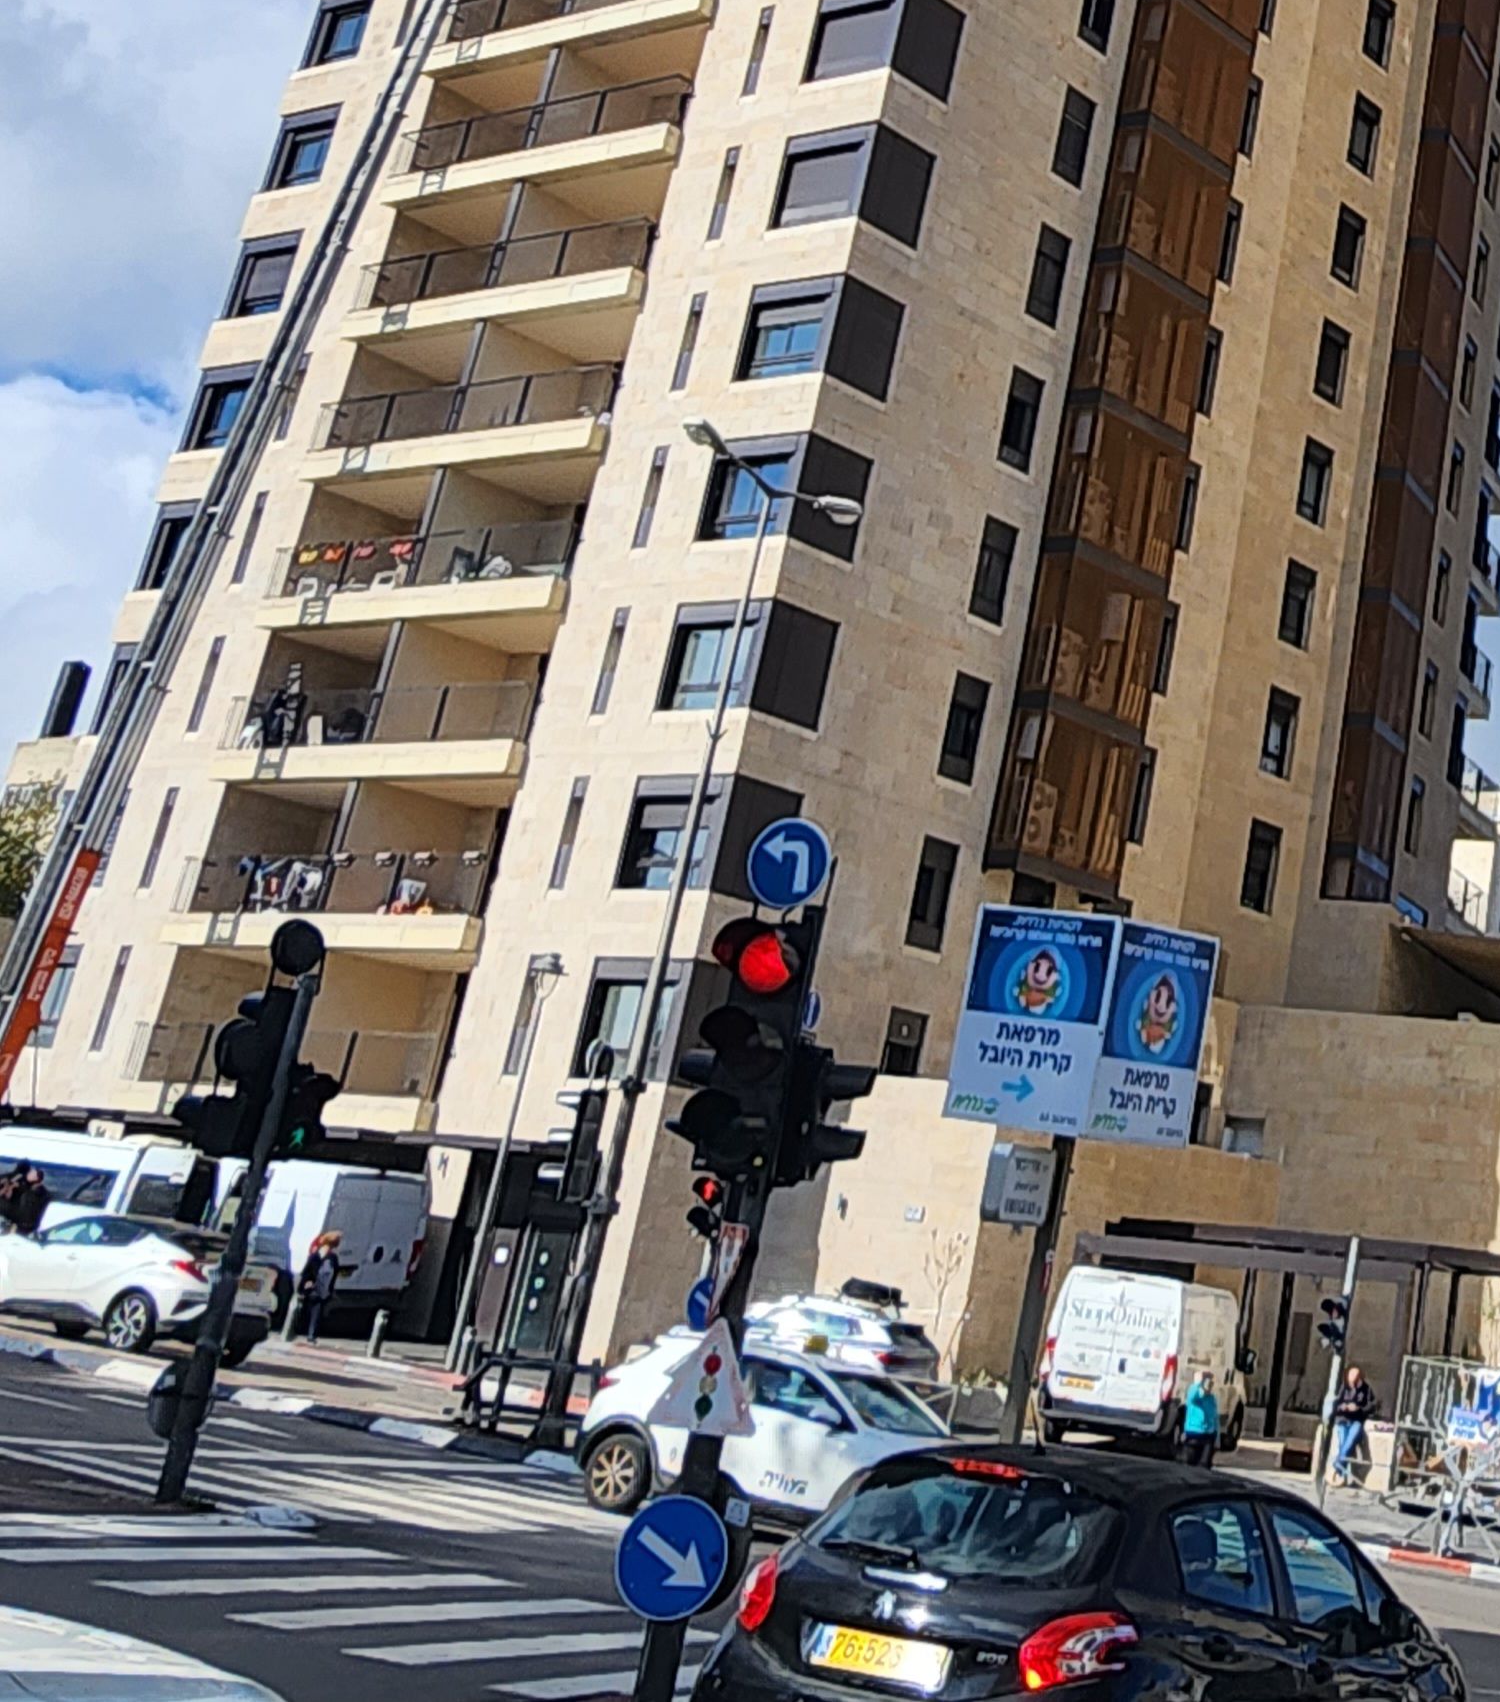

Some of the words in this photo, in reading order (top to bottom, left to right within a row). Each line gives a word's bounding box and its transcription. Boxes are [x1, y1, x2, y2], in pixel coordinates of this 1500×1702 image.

[996, 1021, 1061, 1046] מרפאת
[978, 1040, 1023, 1067] היובל
[1027, 1049, 1073, 1075] קרית
[1122, 1066, 1170, 1091] מרפאת
[1109, 1086, 1142, 1112] היובל
[1144, 1094, 1177, 1119] קרית
